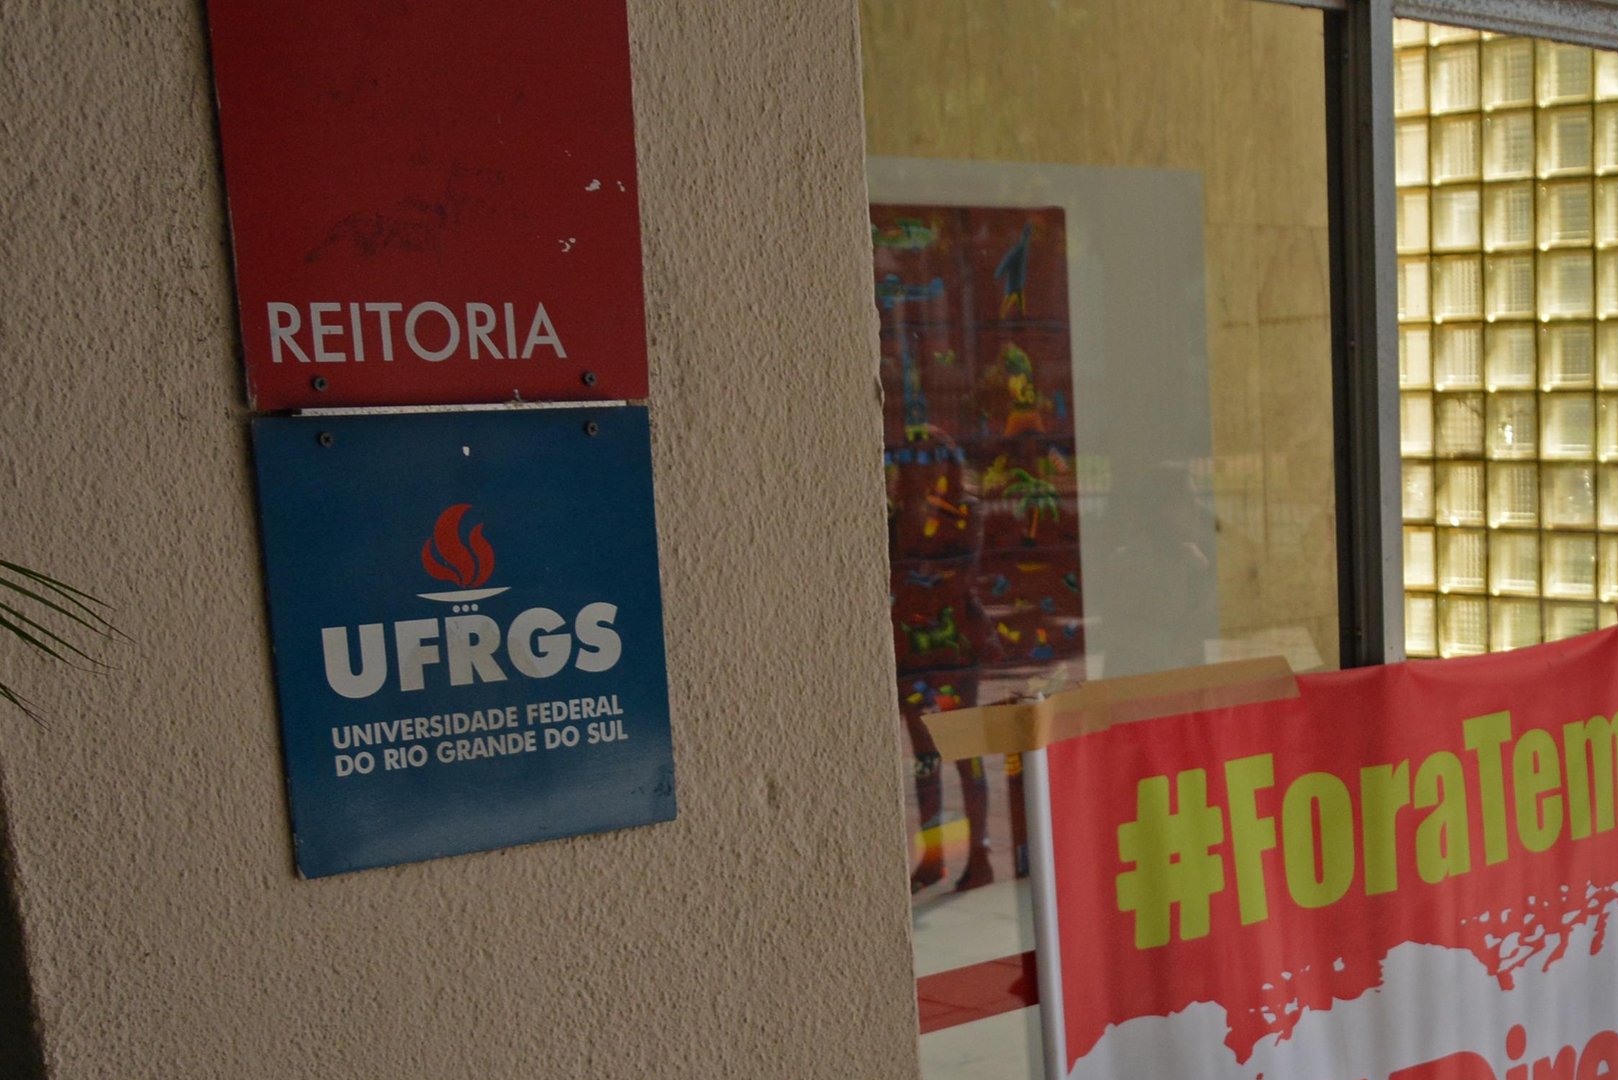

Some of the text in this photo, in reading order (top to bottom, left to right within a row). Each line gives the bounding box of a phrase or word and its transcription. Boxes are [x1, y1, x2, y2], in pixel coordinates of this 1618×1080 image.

[266, 301, 568, 363] REITORIA
[321, 602, 623, 699] UFRGS
[331, 695, 624, 750] UNIVERSIDADE FEDERAL
[334, 719, 629, 778] DO RIO GRANDE DO SUL
